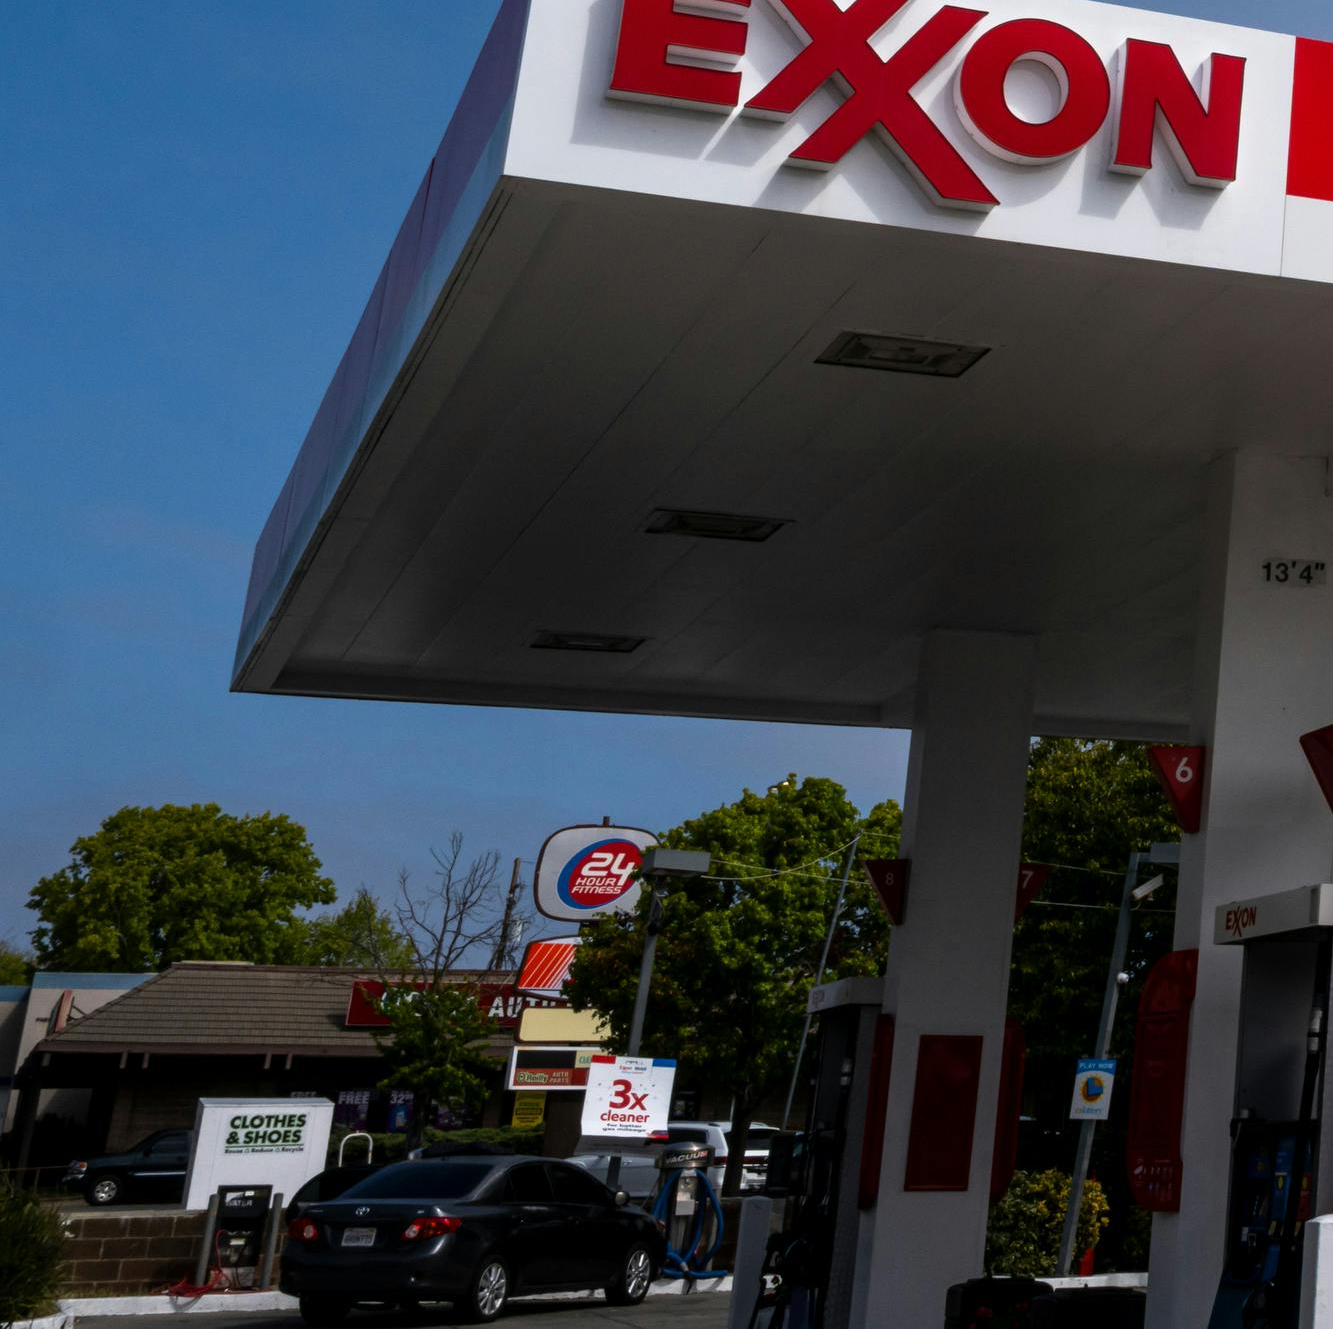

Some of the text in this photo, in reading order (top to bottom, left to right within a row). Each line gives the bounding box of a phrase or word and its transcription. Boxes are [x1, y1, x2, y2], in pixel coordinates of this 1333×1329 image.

[1174, 758, 1193, 784] 6
[581, 852, 635, 886] 24
[575, 877, 617, 886] HOUR
[884, 872, 895, 887] 8
[1021, 869, 1035, 890] 7
[571, 885, 622, 895] FITNESS
[1226, 906, 1257, 937] EXXON
[338, 1091, 370, 1104] FREE
[609, 1079, 649, 1111] 3x
[230, 1114, 307, 1129] CLOTHES
[600, 1110, 650, 1123] cleaner
[225, 1130, 302, 1145] & SHOES
[665, 1150, 709, 1164] VACUUM
